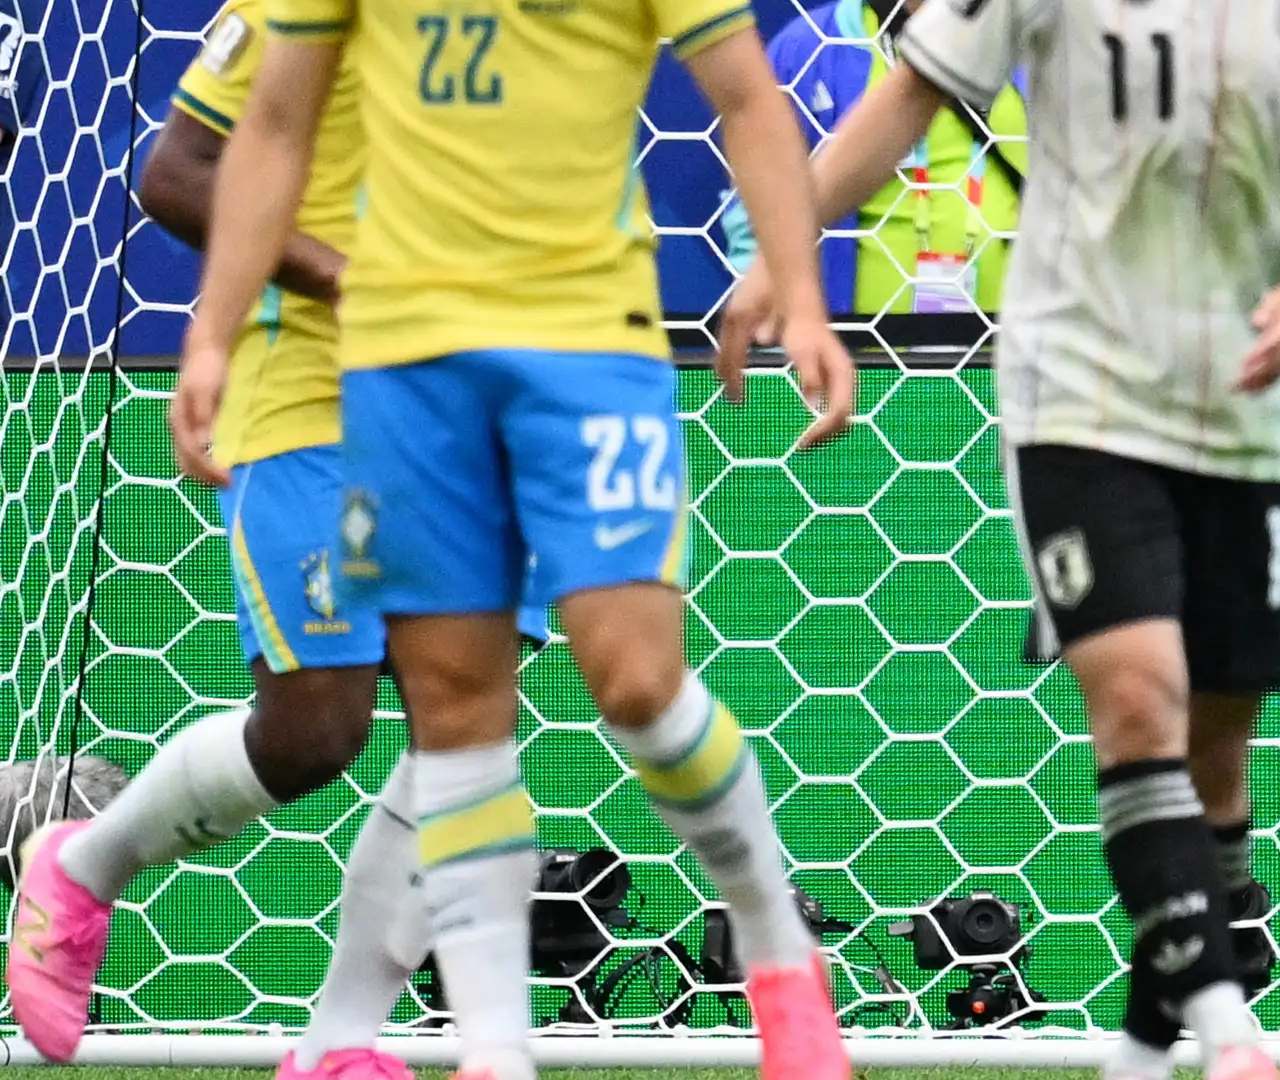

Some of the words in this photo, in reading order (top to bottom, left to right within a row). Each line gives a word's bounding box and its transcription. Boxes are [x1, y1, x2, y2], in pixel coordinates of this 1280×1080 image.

[417, 16, 502, 102] 22
[1102, 32, 1174, 121] 11
[582, 414, 676, 511] 22
